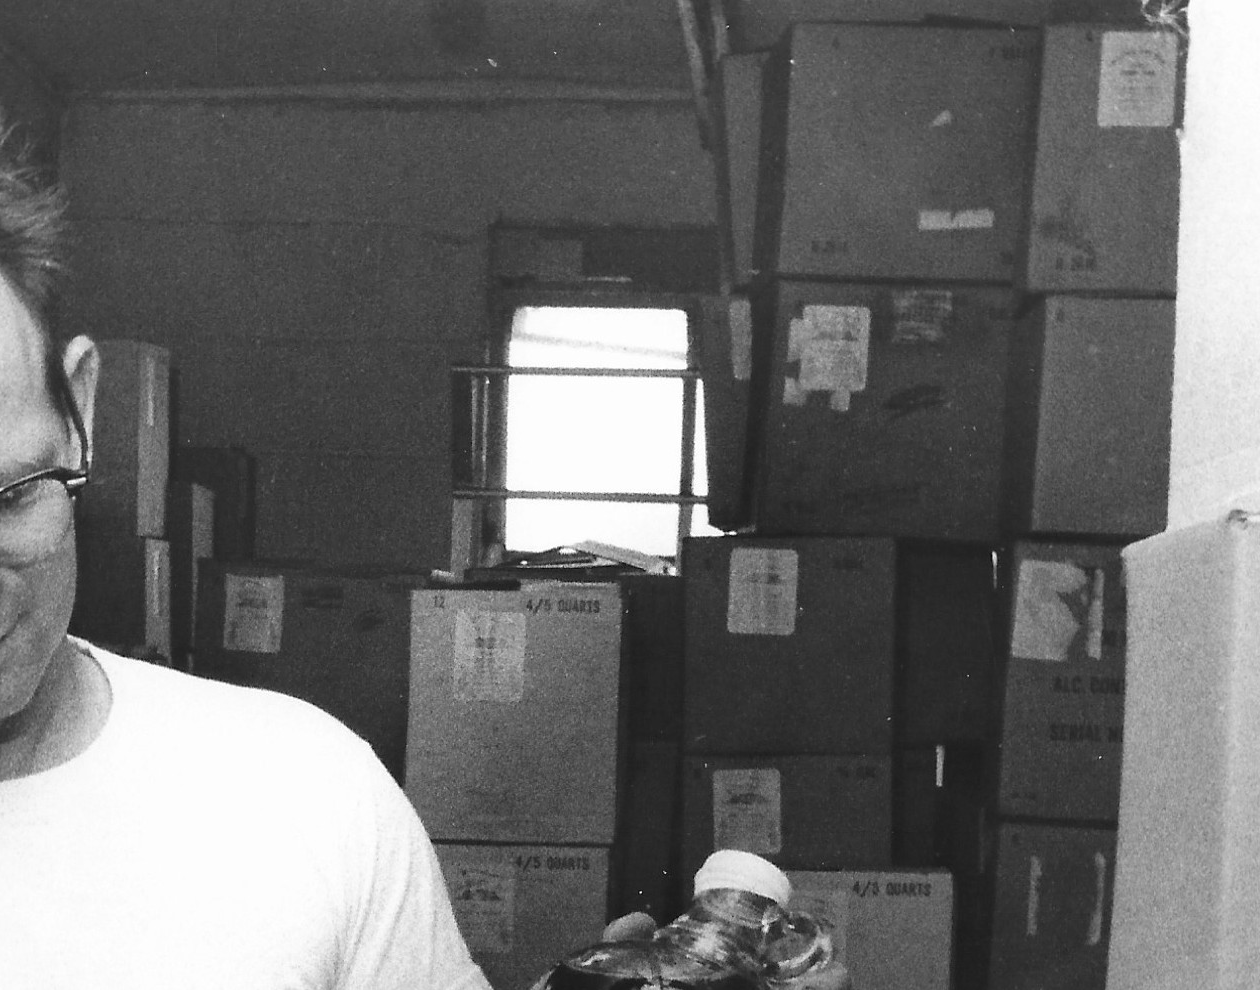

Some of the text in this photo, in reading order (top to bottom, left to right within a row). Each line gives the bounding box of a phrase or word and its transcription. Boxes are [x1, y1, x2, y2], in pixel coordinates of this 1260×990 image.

[525, 598, 551, 615] 4/5
[557, 599, 601, 614] QUARTS
[516, 855, 590, 872] 4/5 QUARTS
[886, 881, 932, 897] QUARTS
